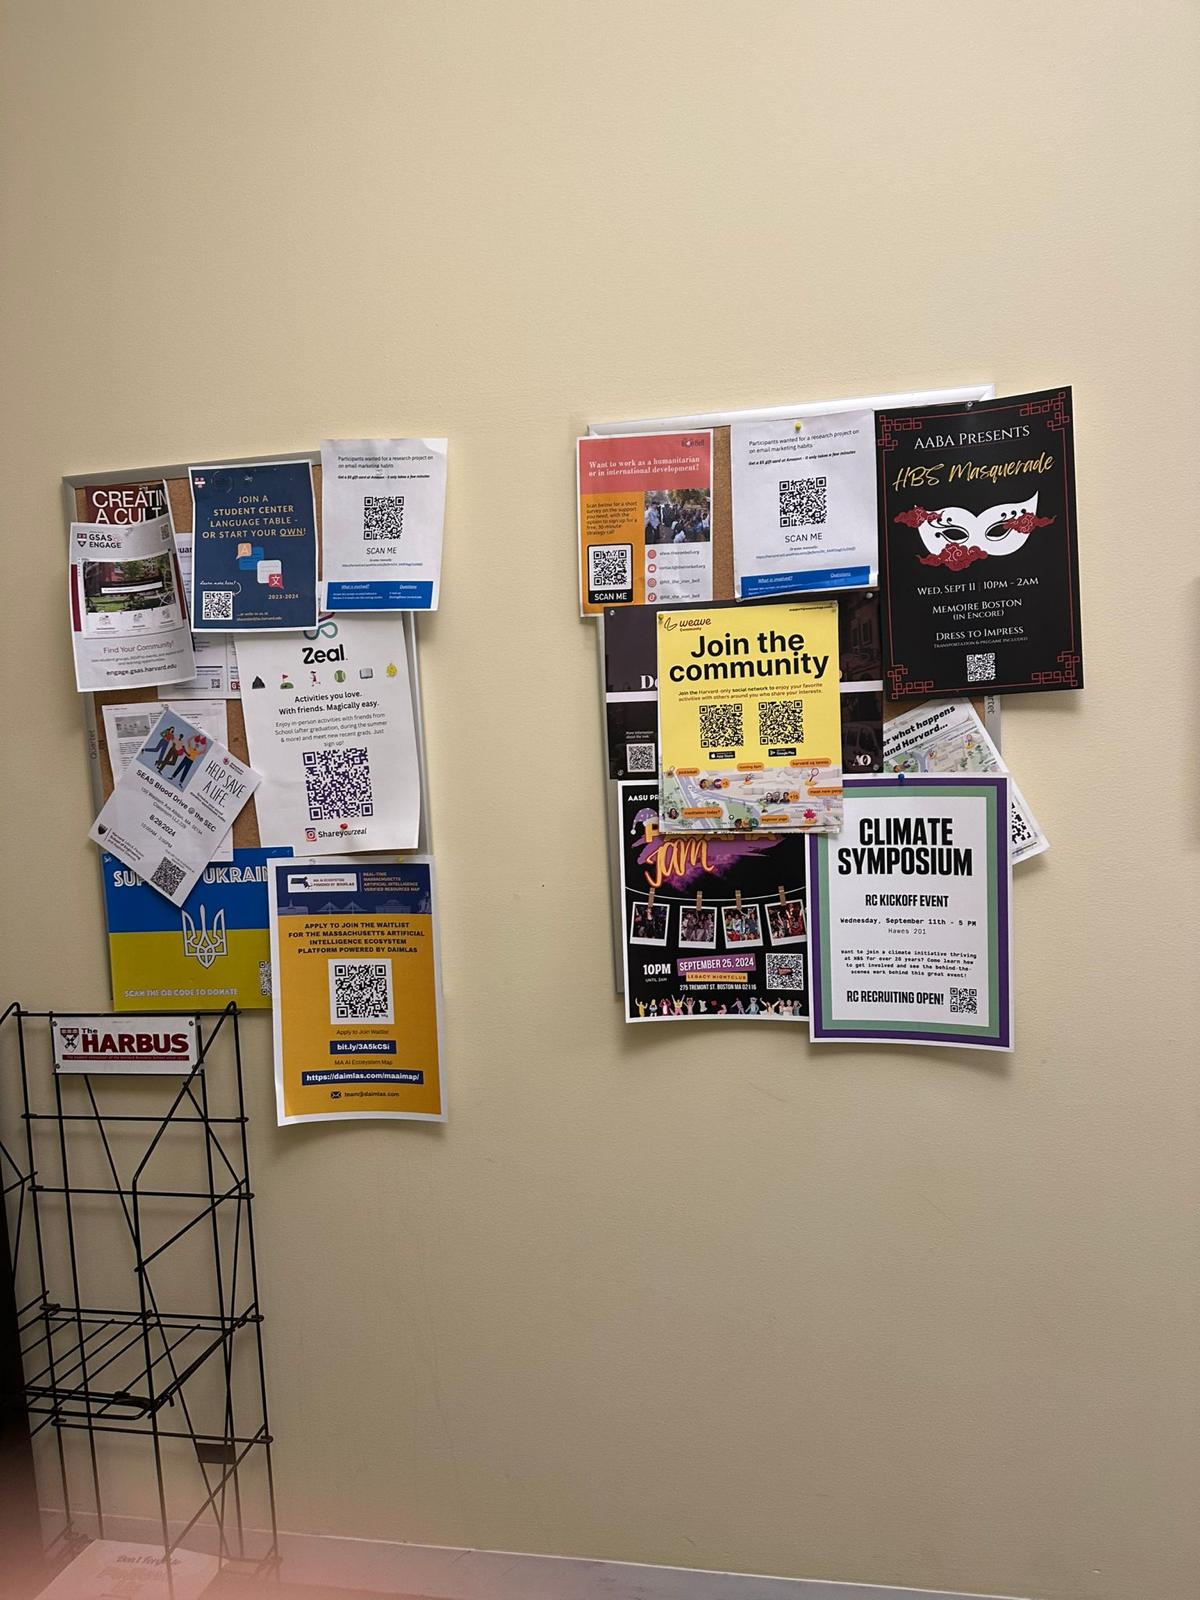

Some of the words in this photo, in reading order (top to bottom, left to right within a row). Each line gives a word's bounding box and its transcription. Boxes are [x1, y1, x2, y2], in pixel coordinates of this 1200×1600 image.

[834, 430, 852, 438] project
[914, 435, 955, 450] AABA
[606, 467, 650, 476] international
[893, 463, 945, 492] HBS
[948, 452, 1055, 484] Masquerade
[214, 507, 255, 516] STUDENT
[259, 505, 294, 514] CENTER
[210, 519, 260, 527] LANGUAGE
[264, 517, 291, 525] TABLE
[251, 529, 276, 537] YOUR
[280, 528, 306, 537] OWN!
[785, 534, 808, 543] SCAN
[944, 583, 966, 594] SEPT
[983, 580, 1008, 590] 10PM
[1016, 577, 1039, 587] 2AM
[932, 603, 980, 614] MEMOIRE
[982, 598, 1022, 610] BOSTON
[968, 609, 1005, 620] ENCORE)
[679, 617, 712, 628] weave
[936, 631, 966, 641] DRESS
[969, 630, 981, 638] TO
[984, 626, 1024, 637] IMPRESS
[690, 632, 749, 658] Join
[757, 630, 805, 654] the
[106, 663, 177, 676] engage.gsas.harvard.edu
[669, 651, 829, 682] community
[294, 694, 328, 703] Activities
[330, 693, 343, 701] you
[345, 690, 362, 698] love.
[279, 707, 296, 715] With
[298, 705, 325, 713] friends.
[326, 702, 360, 711] Magically
[362, 700, 379, 708] easy.
[892, 725, 915, 741] what
[916, 706, 955, 730] happens
[205, 760, 225, 780] HELP
[226, 776, 246, 799] SAVE
[136, 769, 154, 785] SEAS
[154, 782, 174, 798] Blood
[173, 795, 189, 809] Drive
[204, 819, 216, 832] SEC
[149, 814, 176, 837] 8/29/2024
[318, 828, 367, 838] Shareyourzeal
[859, 818, 953, 845] CLIMATE
[838, 847, 973, 876] SYMPOSIUM
[865, 895, 878, 906] RC
[880, 895, 917, 907] KICKOFF
[919, 896, 949, 907] EVENT
[643, 963, 671, 975] 10PM
[680, 958, 721, 972] SEPTEMBER
[735, 957, 754, 968] 2024
[847, 991, 859, 1002] RC
[861, 991, 914, 1004] RECRUITING
[916, 993, 944, 1005] OPEN!
[82, 1034, 189, 1053] HARBUS
